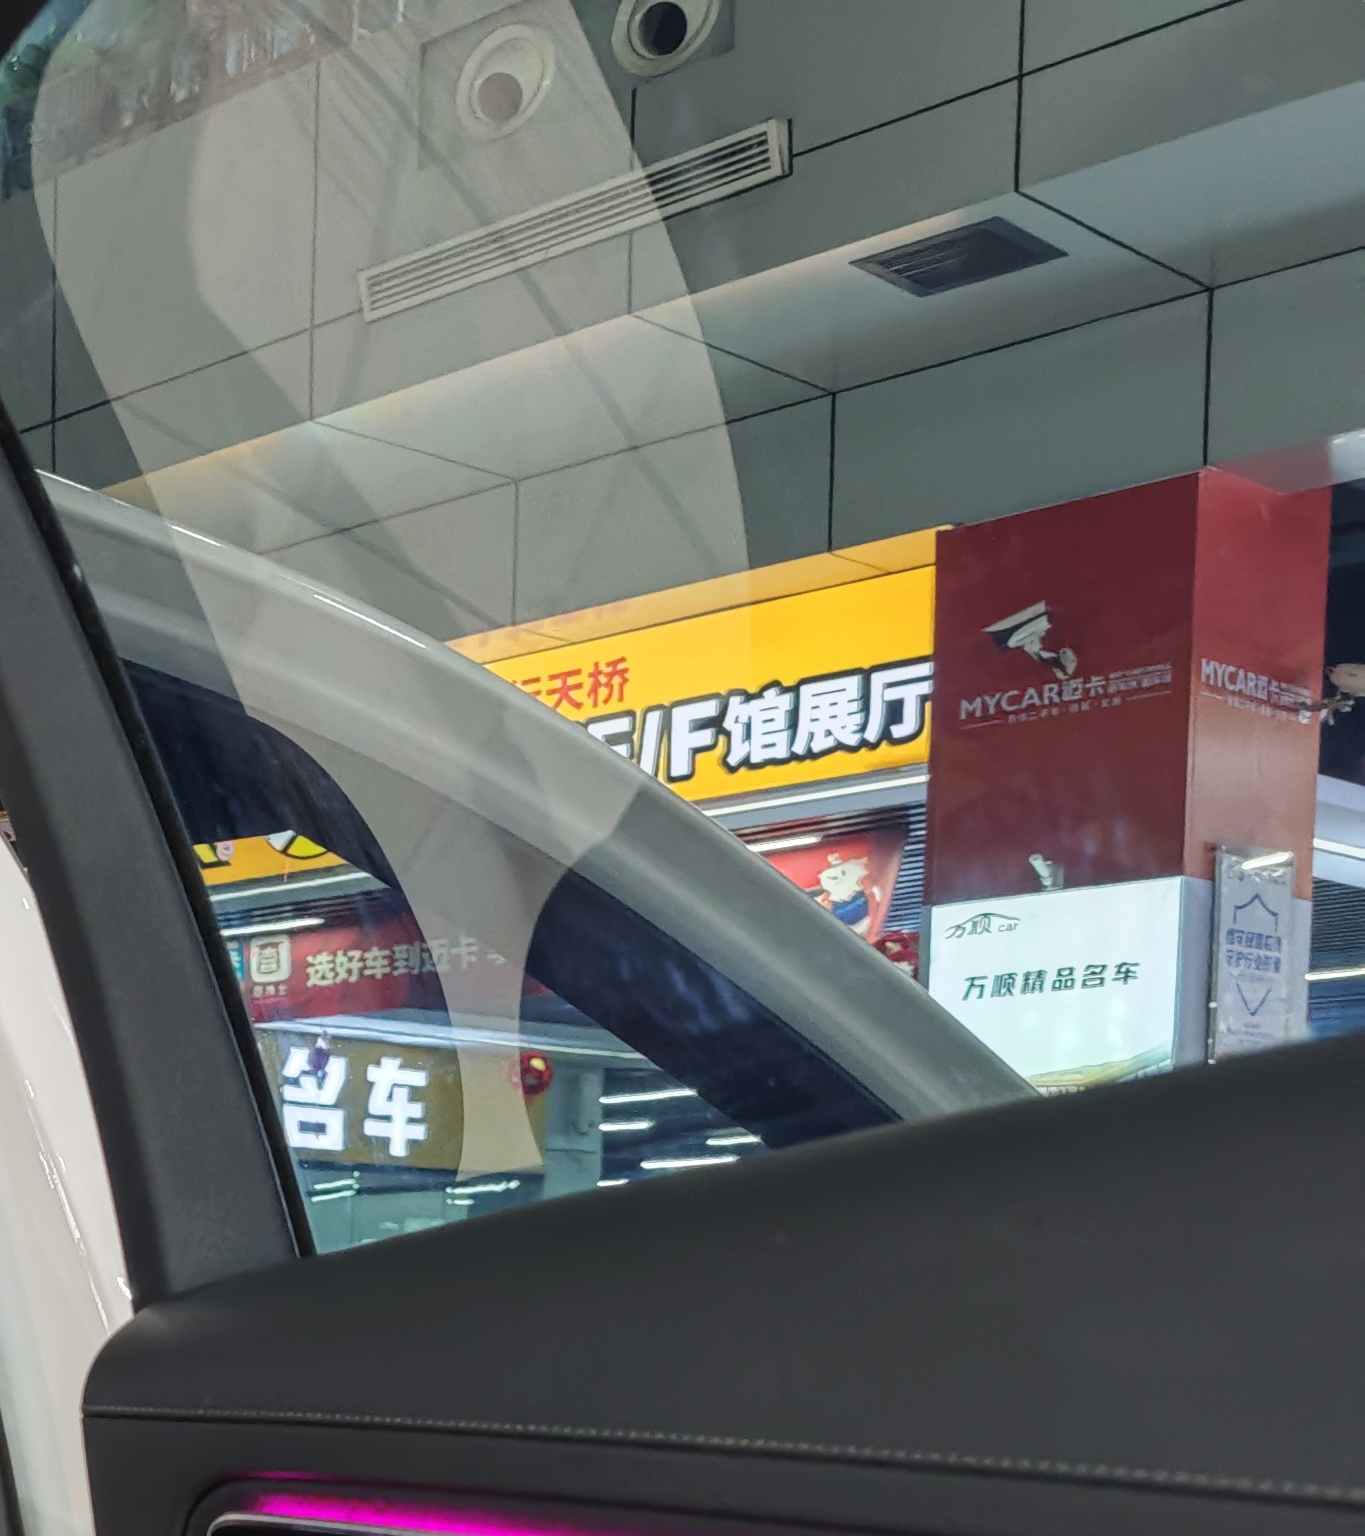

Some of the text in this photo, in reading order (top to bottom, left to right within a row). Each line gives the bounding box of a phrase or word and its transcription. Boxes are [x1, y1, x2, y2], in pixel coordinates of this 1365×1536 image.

[997, 921, 1020, 933] car
[961, 961, 1141, 1001] 万顺精品名车
[282, 1046, 429, 1158] 名车
